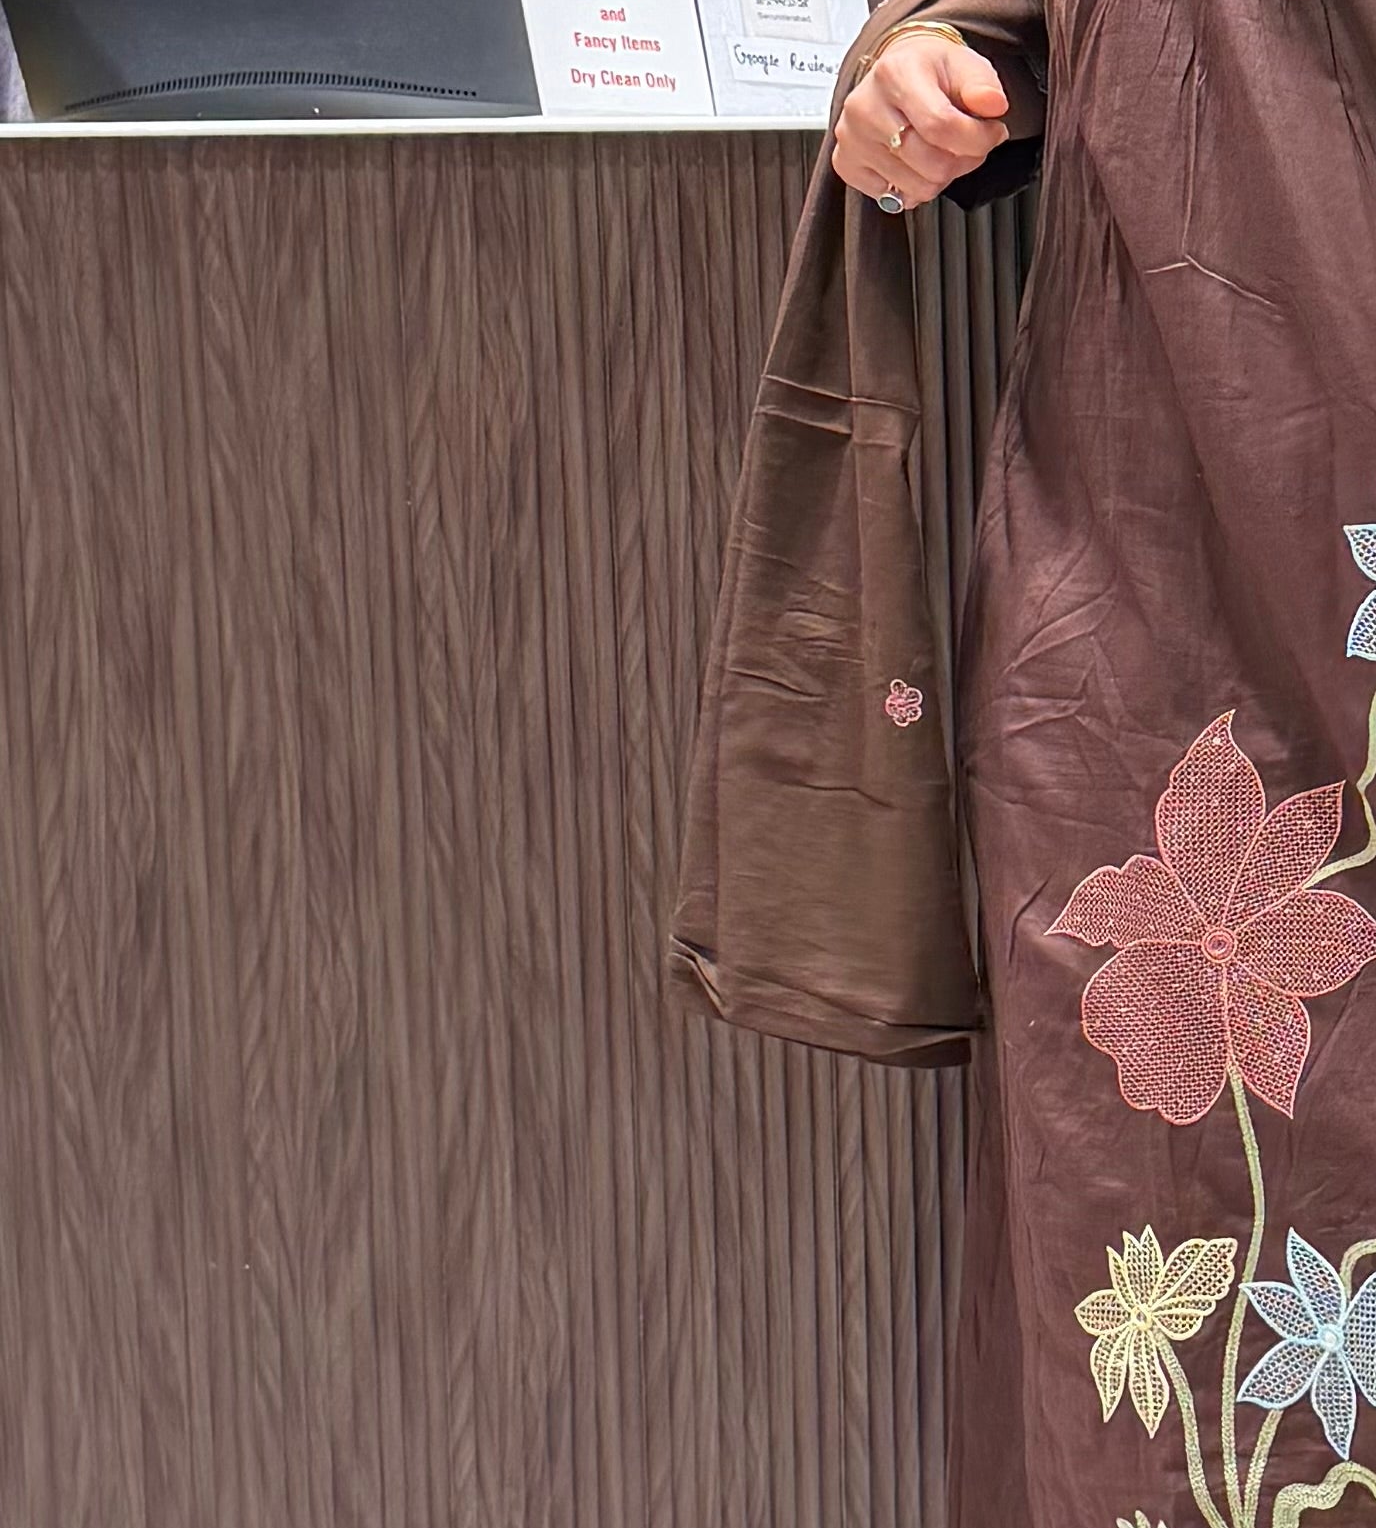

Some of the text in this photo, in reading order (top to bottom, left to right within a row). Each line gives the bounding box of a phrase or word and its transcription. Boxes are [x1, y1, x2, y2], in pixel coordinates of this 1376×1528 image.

[600, 7, 626, 22] and
[574, 31, 662, 52] Fancy Items
[570, 68, 676, 92] Dry Clean Only
